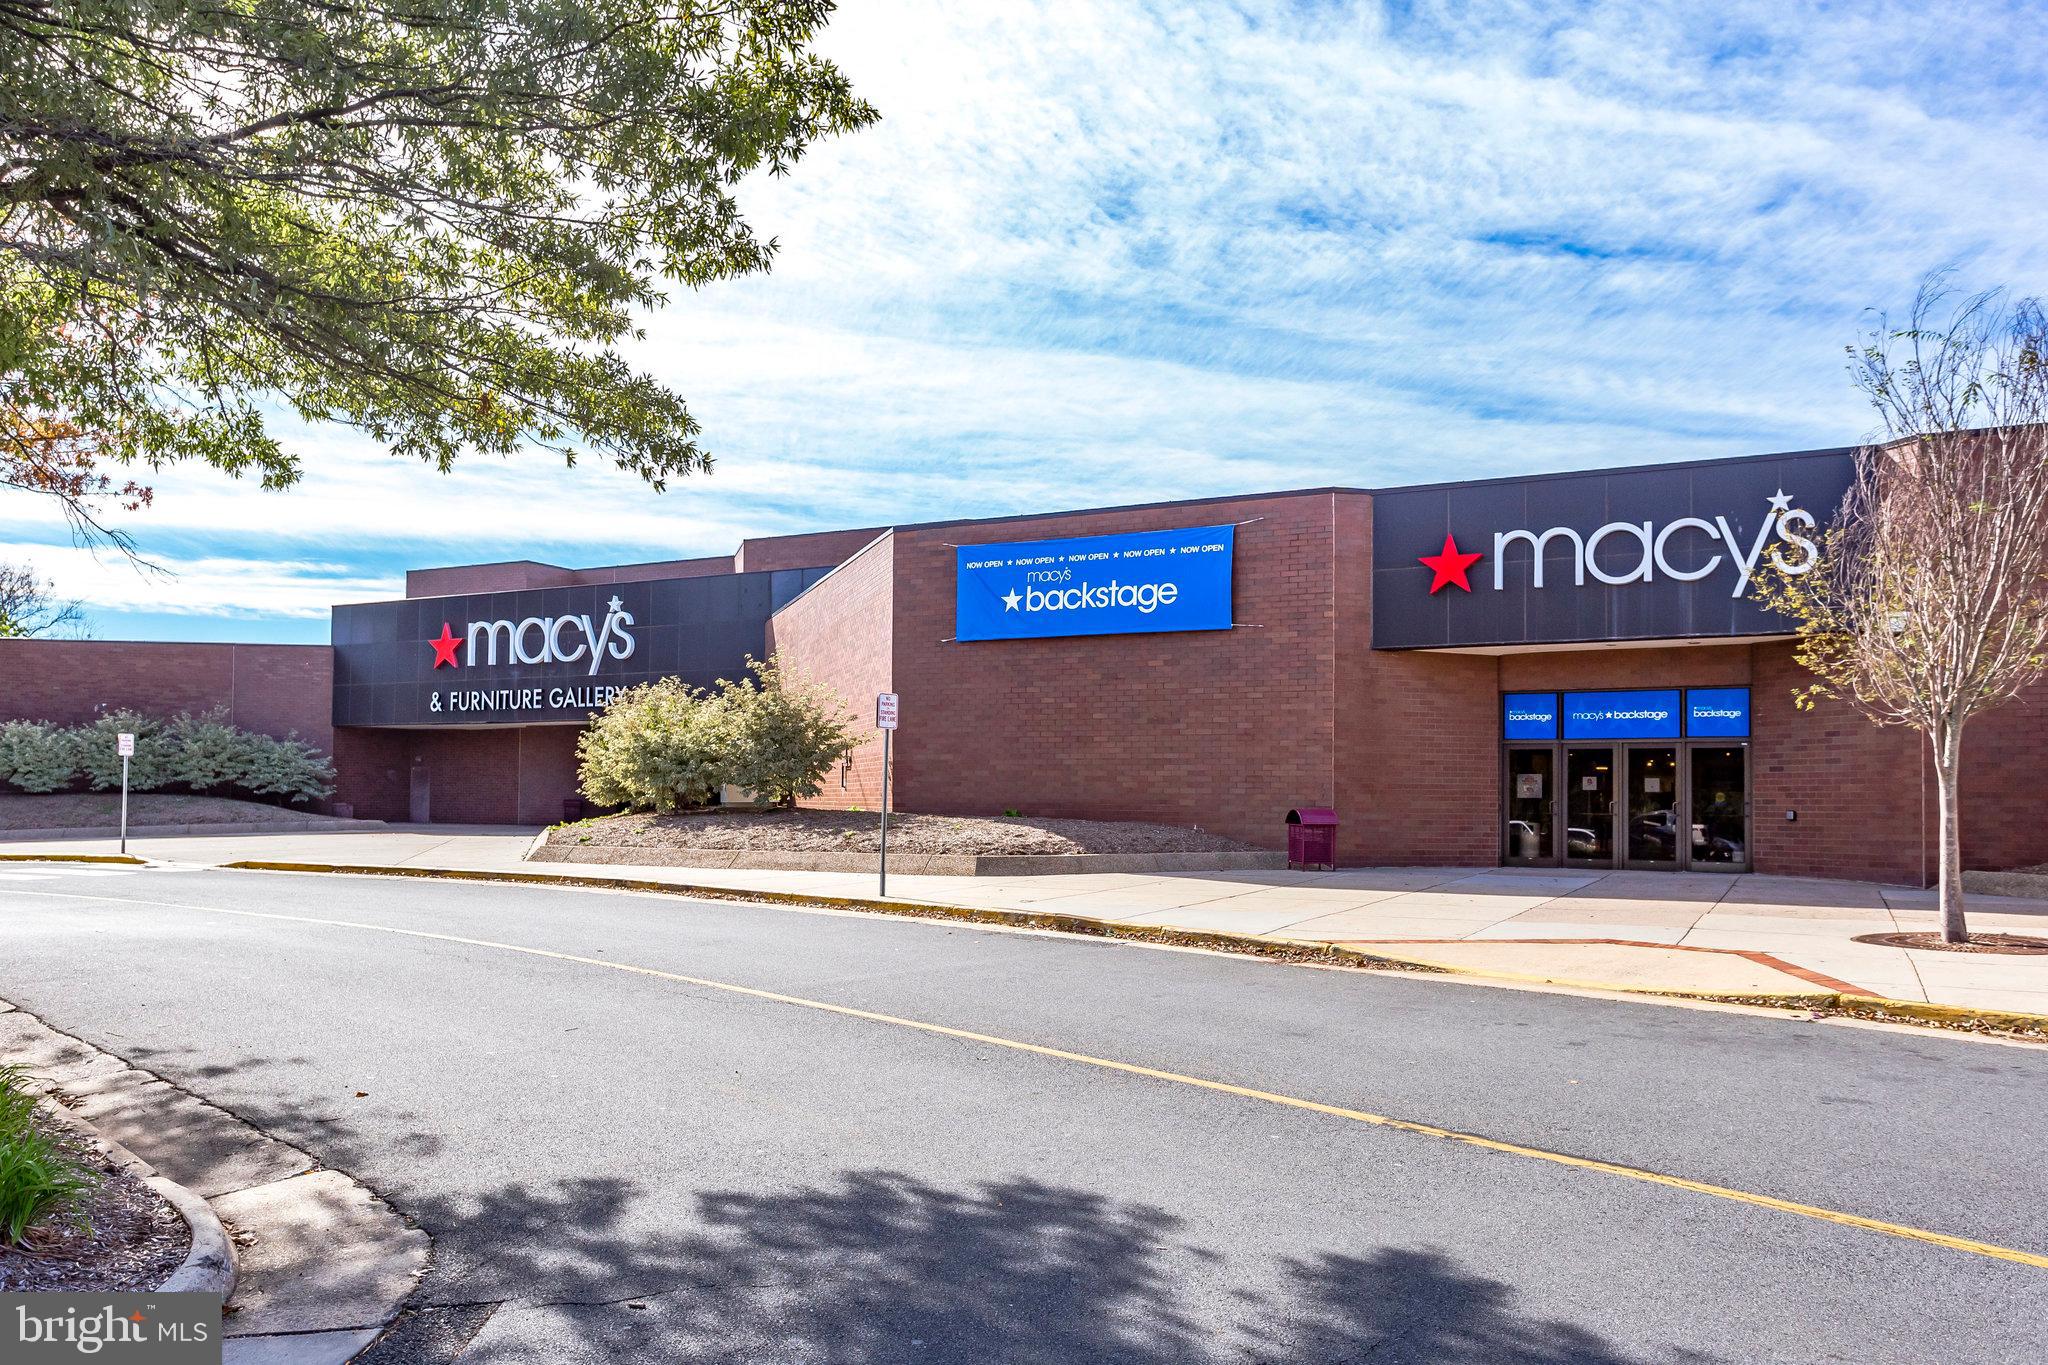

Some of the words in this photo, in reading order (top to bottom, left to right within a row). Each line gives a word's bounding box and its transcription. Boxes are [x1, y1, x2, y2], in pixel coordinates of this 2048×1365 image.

[1493, 488, 1818, 599] macy's
[966, 562, 983, 570] NOW
[984, 560, 1004, 568] OPEN
[1015, 558, 1034, 566] NOW
[1034, 556, 1055, 565] OPEN
[1068, 554, 1087, 562] NOW
[1088, 552, 1110, 561] OPEN
[1123, 550, 1142, 558] NOW
[1143, 548, 1166, 557] OPEN
[1180, 545, 1200, 554] NOW
[1201, 543, 1225, 553] OPEN
[1027, 566, 1072, 585] macy's
[1025, 579, 1178, 614] backstage
[466, 595, 635, 676] macy's
[429, 692, 443, 712] &
[449, 688, 543, 711] FURNITURE
[1508, 713, 1553, 722] backstage
[1572, 711, 1604, 721] macy's
[1613, 709, 1668, 721] backstage
[1693, 709, 1742, 719] backstage
